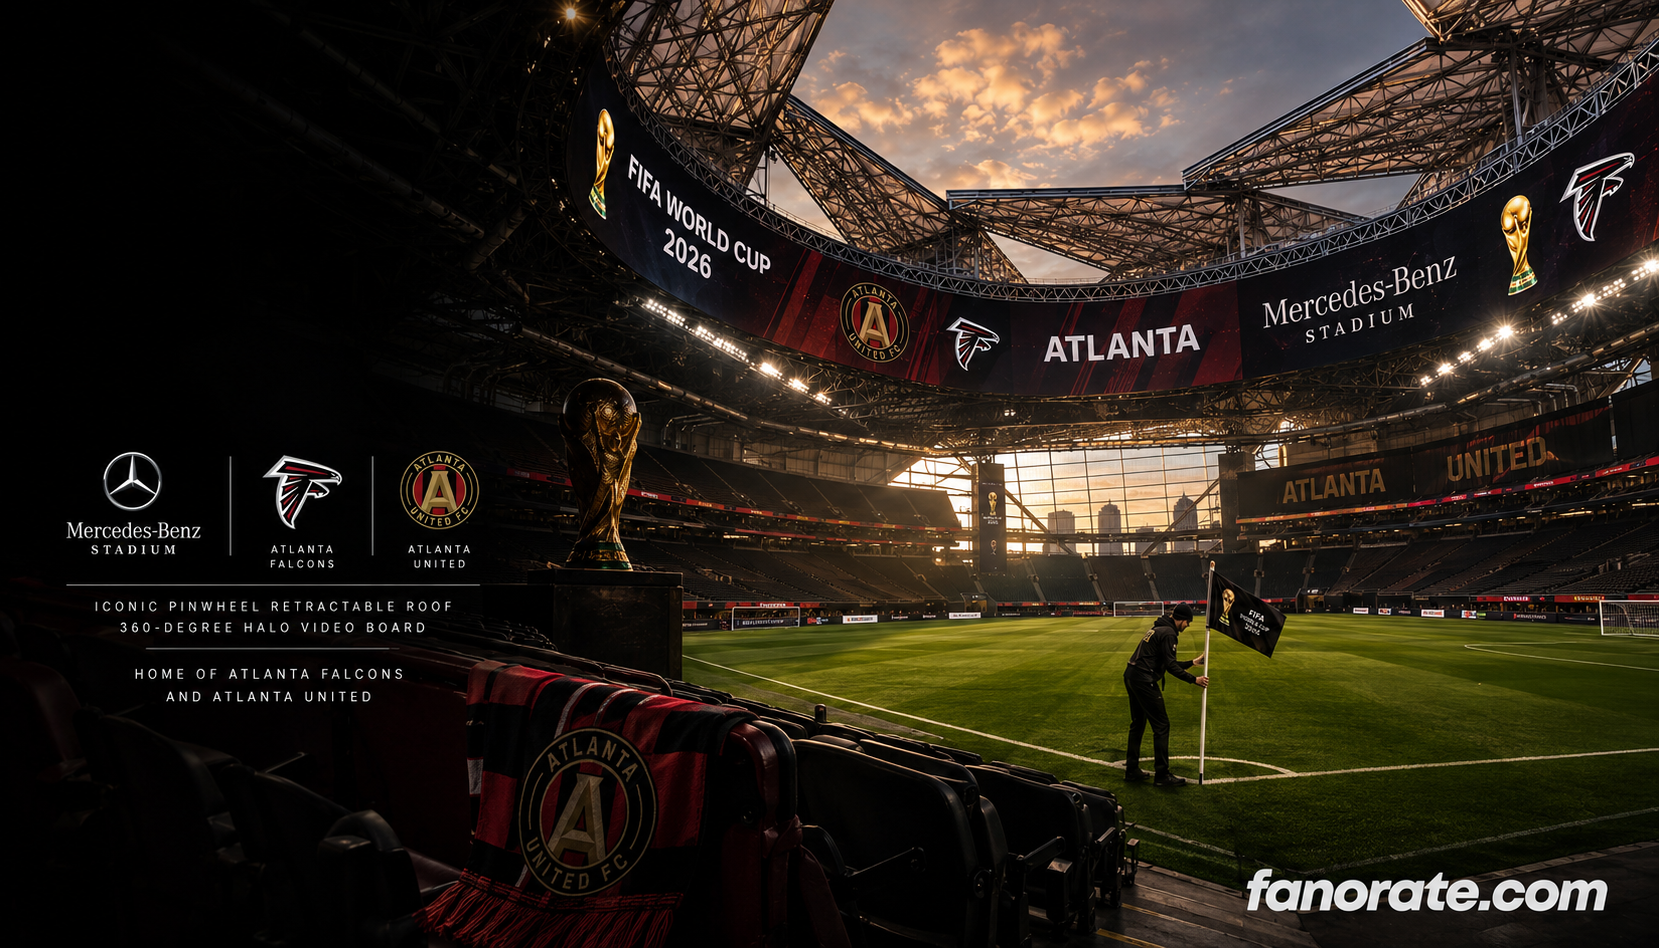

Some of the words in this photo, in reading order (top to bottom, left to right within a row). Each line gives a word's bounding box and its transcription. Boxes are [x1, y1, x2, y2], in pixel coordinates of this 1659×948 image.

[628, 153, 662, 208] FIFA
[666, 189, 730, 253] WORLD
[733, 240, 771, 274] CUP
[662, 227, 712, 279] 2026
[852, 285, 898, 310] ATLANTA
[1262, 255, 1458, 329] Mercedes-Benz
[848, 332, 886, 360] UNITED
[888, 344, 901, 358] FC
[858, 301, 891, 348] A
[1043, 323, 1201, 363] ATLANTA
[1305, 303, 1415, 344] STADIUM
[1446, 436, 1548, 482] UNITED
[1282, 468, 1387, 504] ATLANTA
[1248, 609, 1265, 623] FIFA
[547, 736, 638, 782] ATLANTA
[548, 772, 606, 866] A
[526, 836, 590, 890] UNITED
[601, 853, 628, 882] FC
